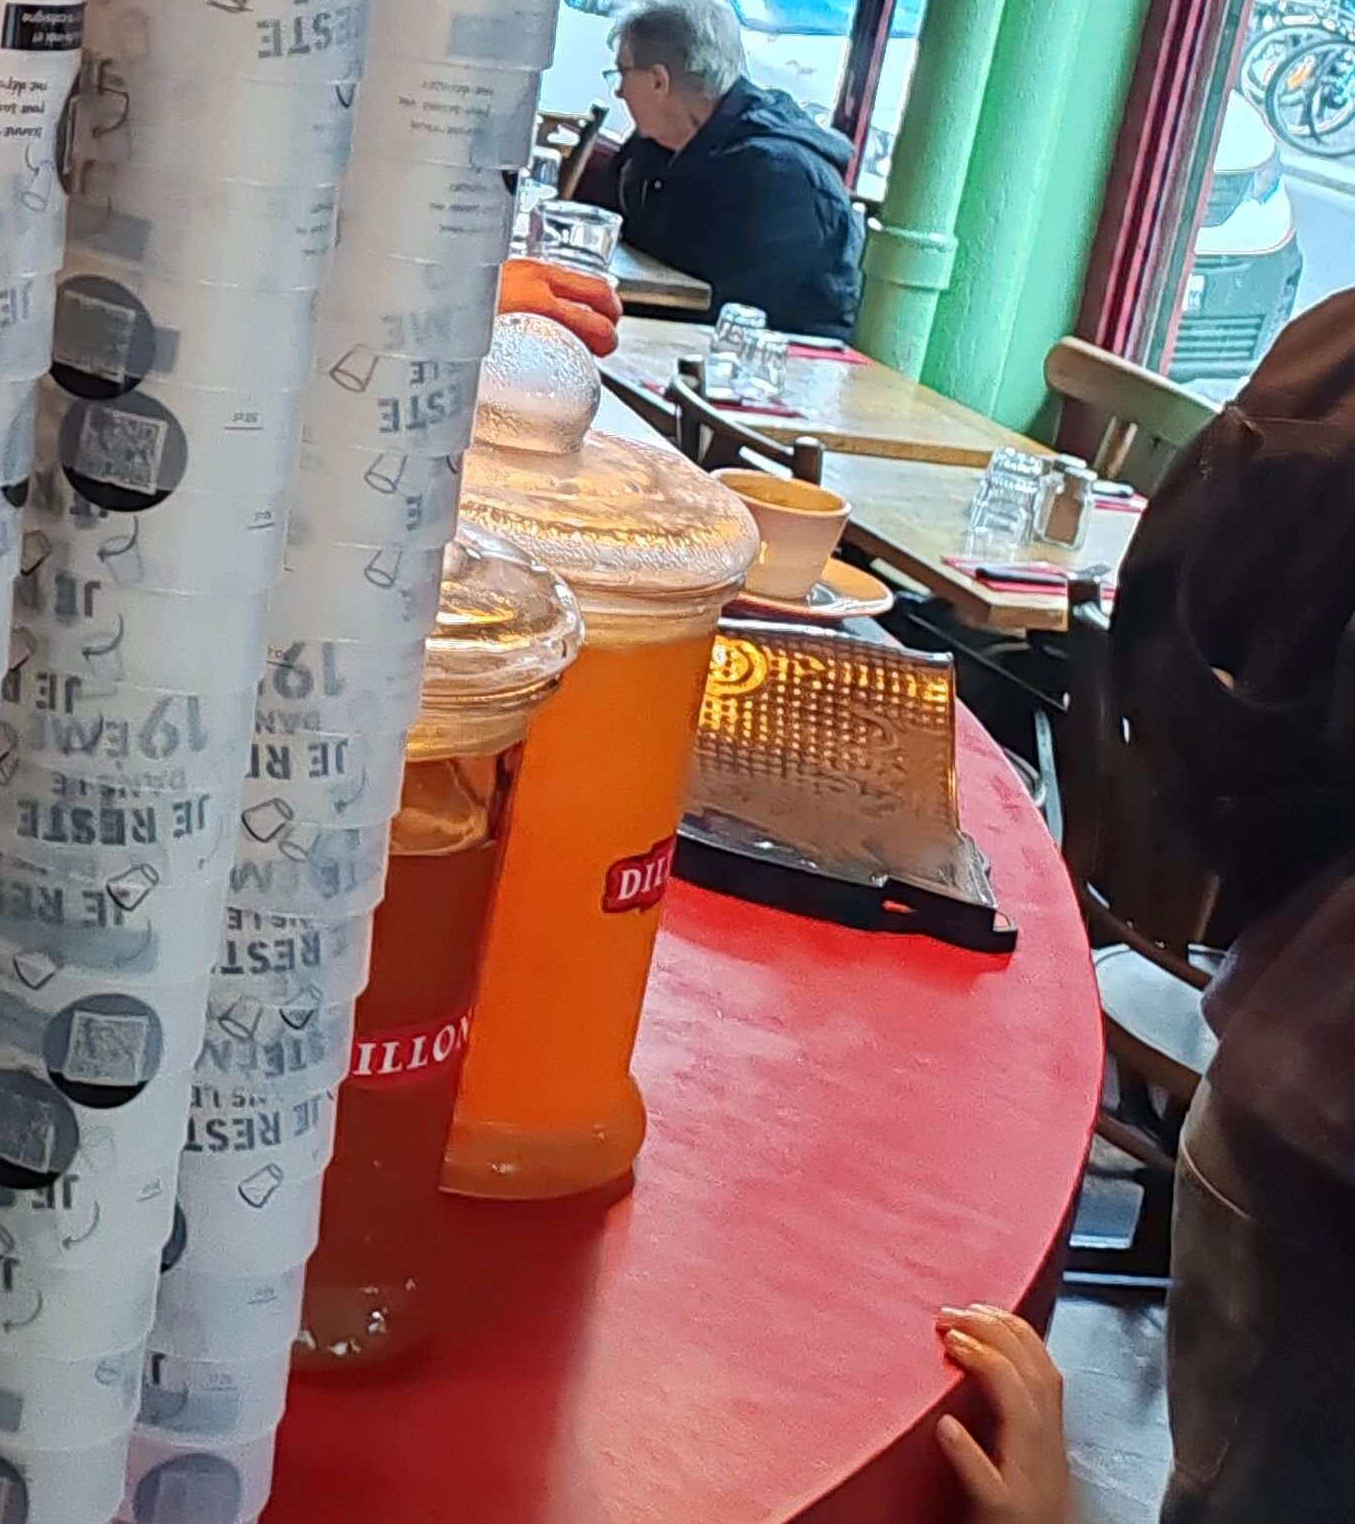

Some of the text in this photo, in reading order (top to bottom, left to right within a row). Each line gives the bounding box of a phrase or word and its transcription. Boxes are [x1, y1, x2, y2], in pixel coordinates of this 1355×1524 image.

[308, 737, 347, 778] JE
[16, 794, 210, 846] JE RESTE
[616, 844, 673, 904] DIL
[211, 931, 321, 975] REST
[353, 1018, 472, 1079] ILLON
[184, 1112, 281, 1153] REST
